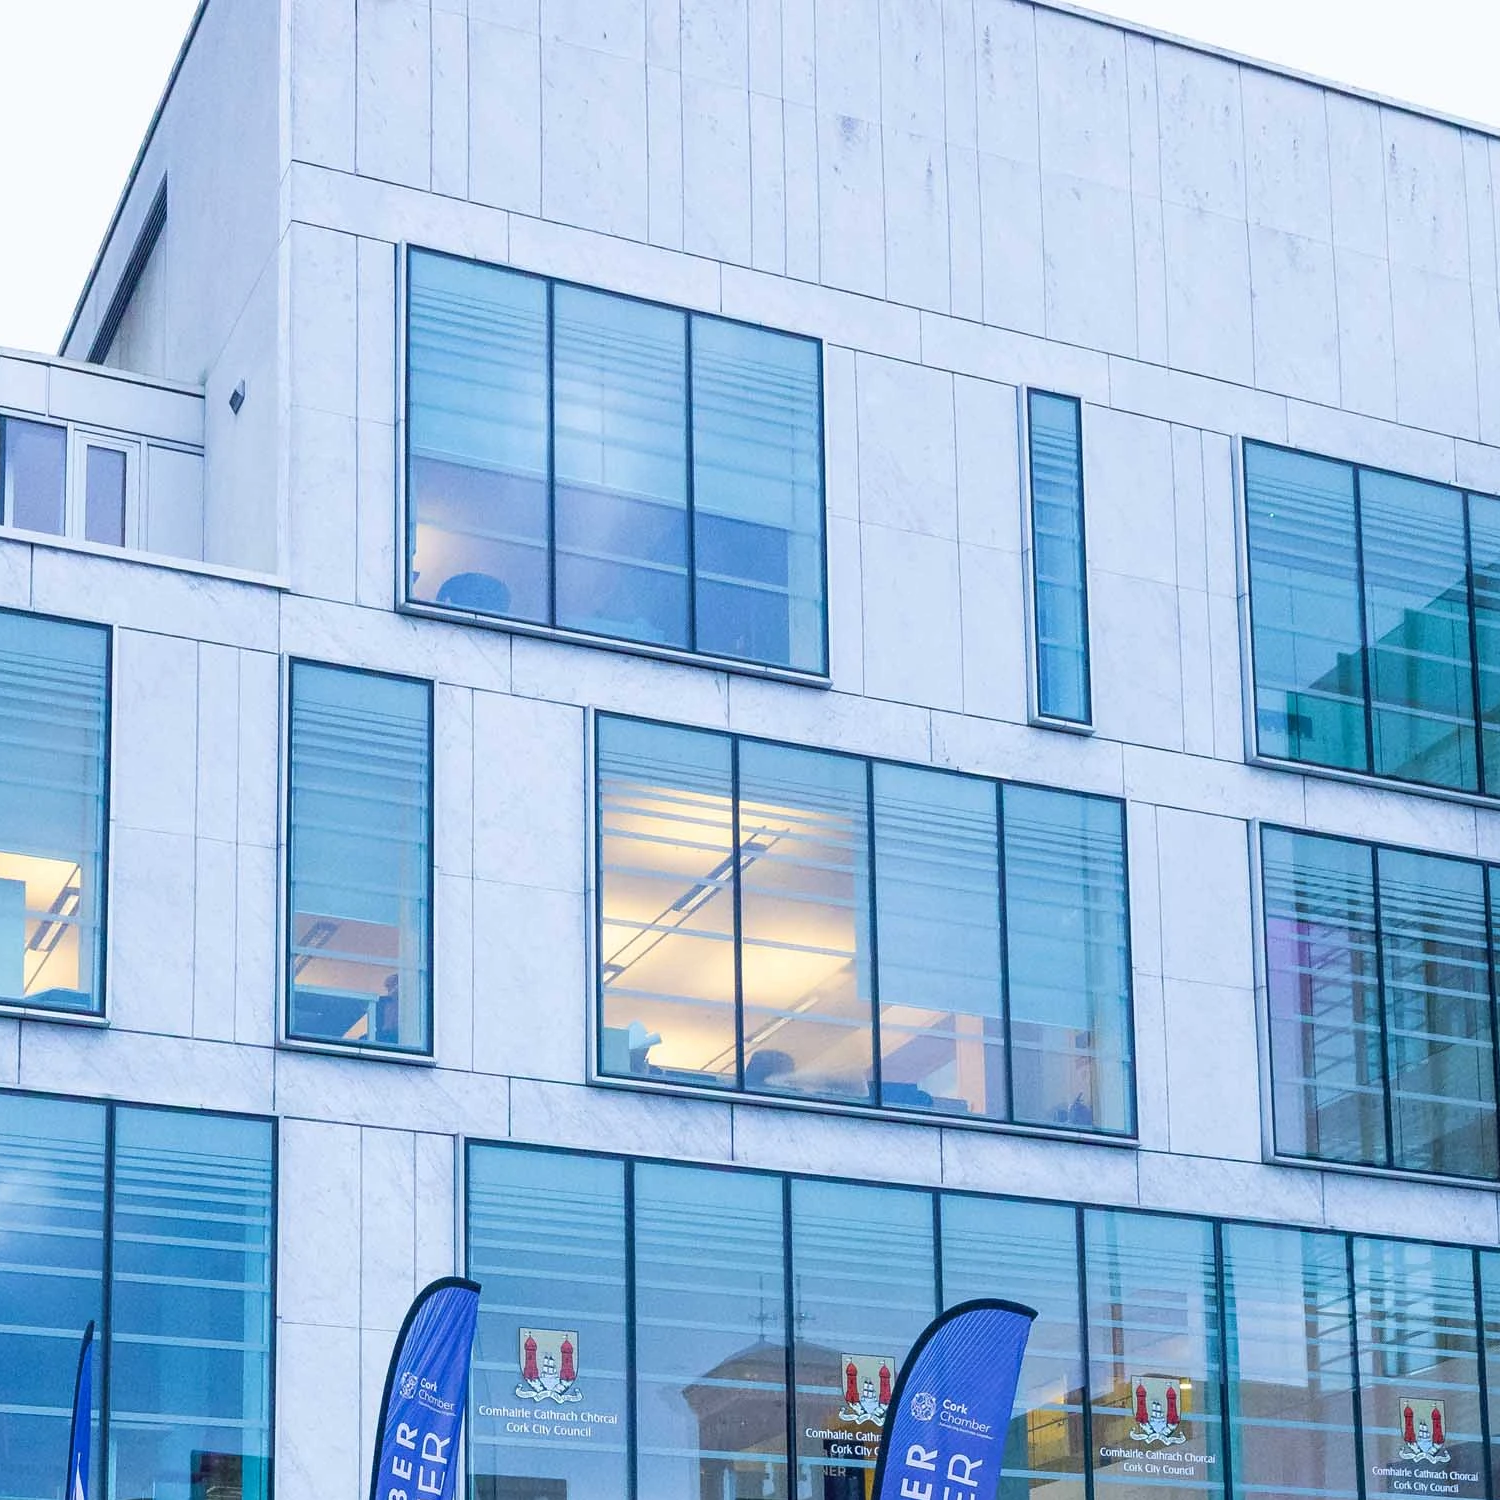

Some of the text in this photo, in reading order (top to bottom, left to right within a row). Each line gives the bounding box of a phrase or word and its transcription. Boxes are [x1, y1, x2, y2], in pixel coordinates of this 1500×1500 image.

[420, 1377, 437, 1392] Cork
[418, 1389, 455, 1411] Chamber
[943, 1399, 968, 1415] Cork
[479, 1405, 531, 1418] Comhairle
[534, 1409, 577, 1421] Cathrach
[940, 1410, 992, 1433] Chamber
[506, 1422, 591, 1437] Cork City Council
[805, 1428, 882, 1442] Comhairle Cathr
[831, 1443, 852, 1455] Cork
[854, 1445, 872, 1457] City
[1099, 1447, 1143, 1459] Comhairle
[1145, 1450, 1182, 1461] Cathrach
[1123, 1462, 1194, 1475] Cork City Council
[1414, 1469, 1448, 1480] Cathrach
[1393, 1481, 1459, 1493] Cork City Council
